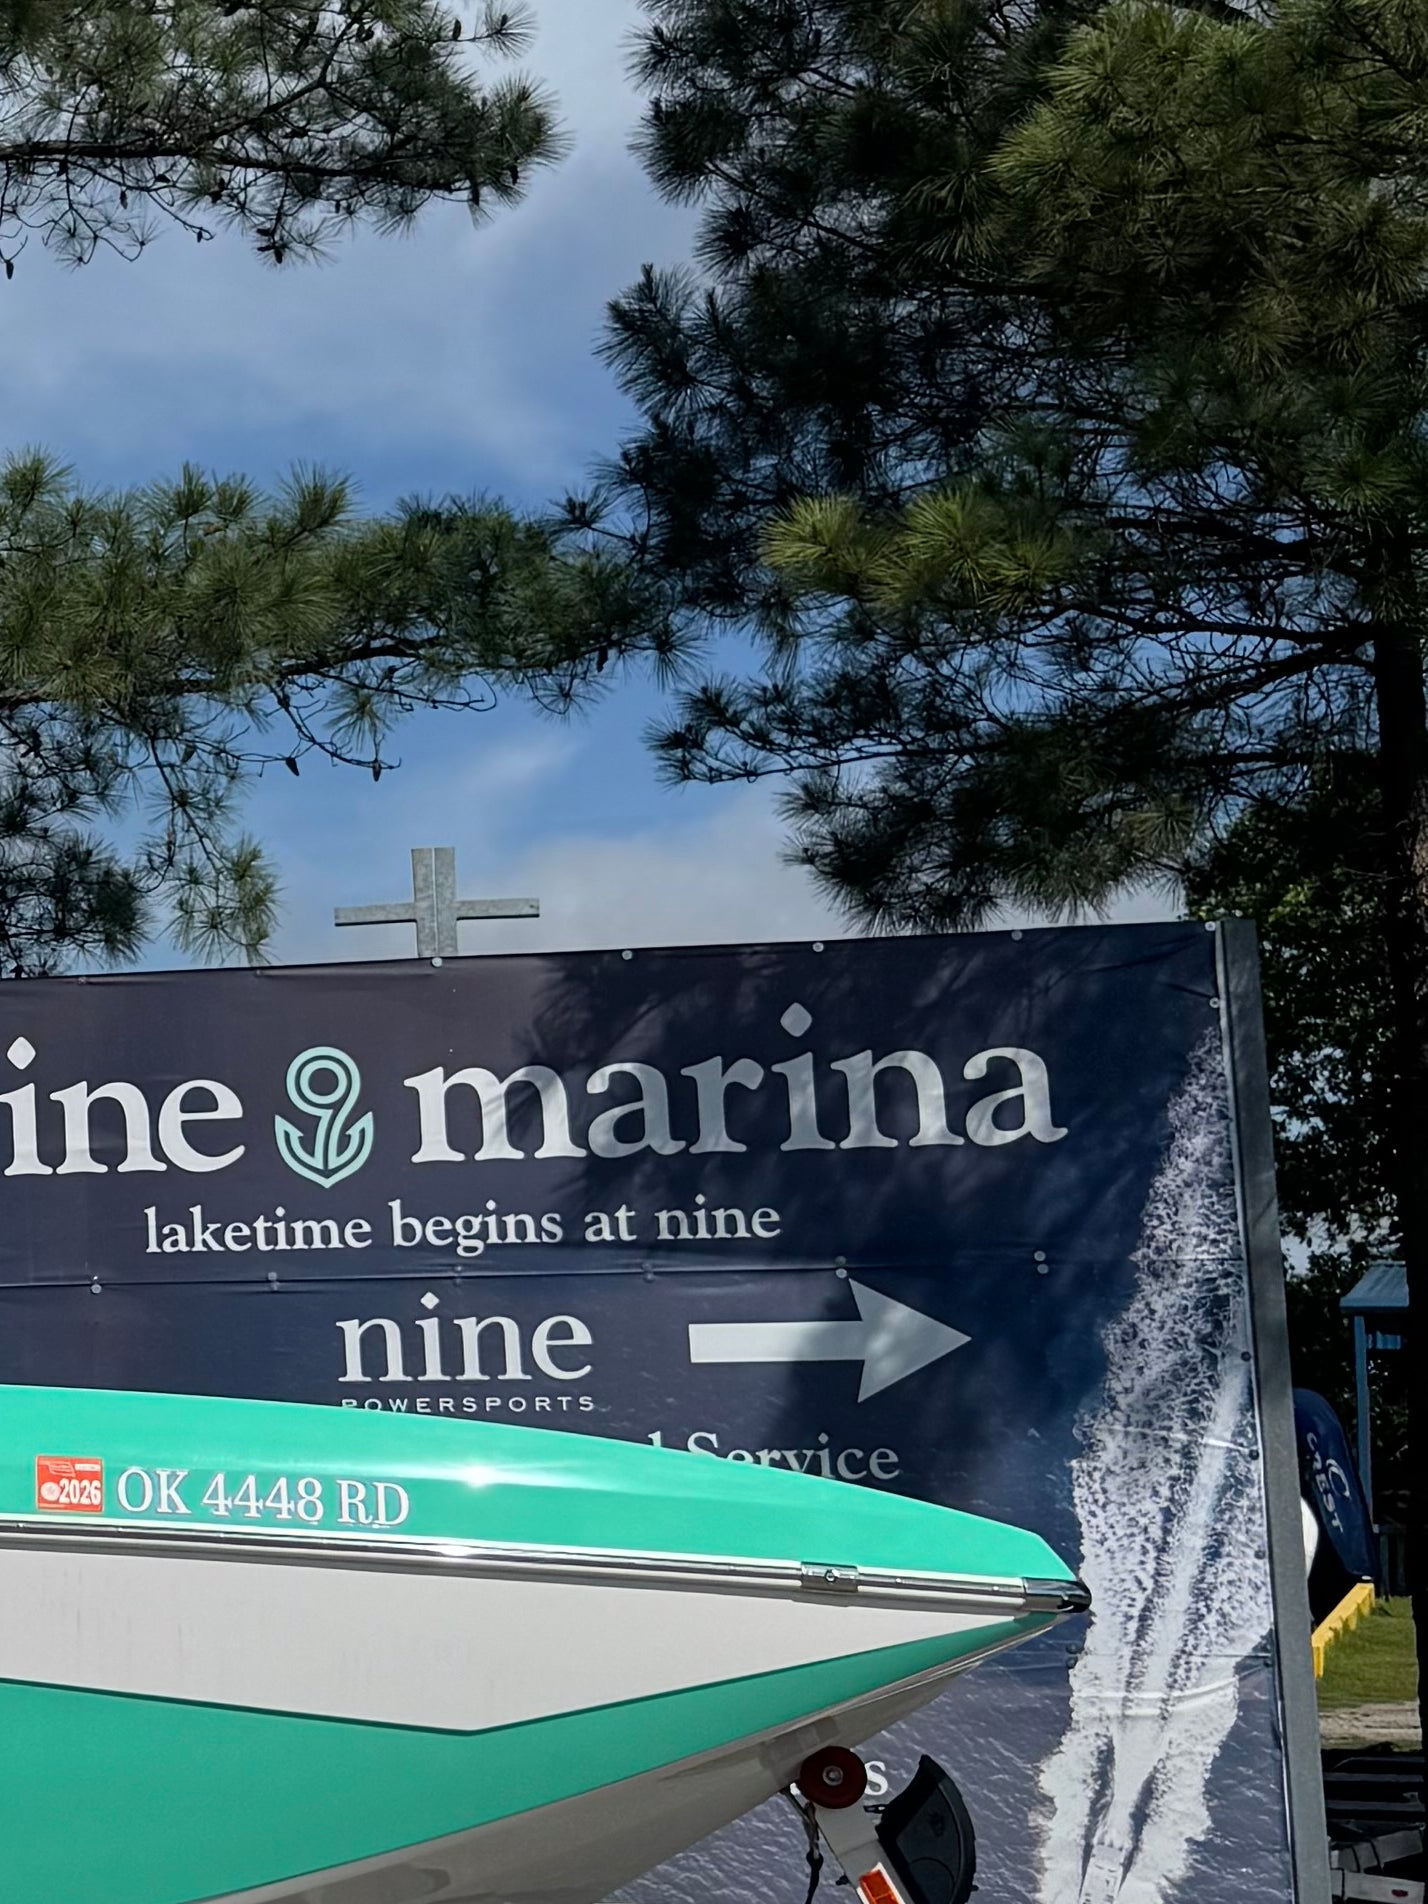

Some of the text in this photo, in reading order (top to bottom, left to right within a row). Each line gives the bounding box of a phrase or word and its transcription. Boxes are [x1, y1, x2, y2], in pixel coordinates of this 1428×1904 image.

[403, 1002, 1068, 1164] marina
[144, 1194, 781, 1256] laketime begins at nine
[335, 1291, 593, 1382] nine
[341, 1396, 595, 1414] POWERSPORTS
[58, 1478, 102, 1506] 2026
[117, 1466, 410, 1526] OK 4448 RD
[1306, 1432, 1344, 1534] CREST
